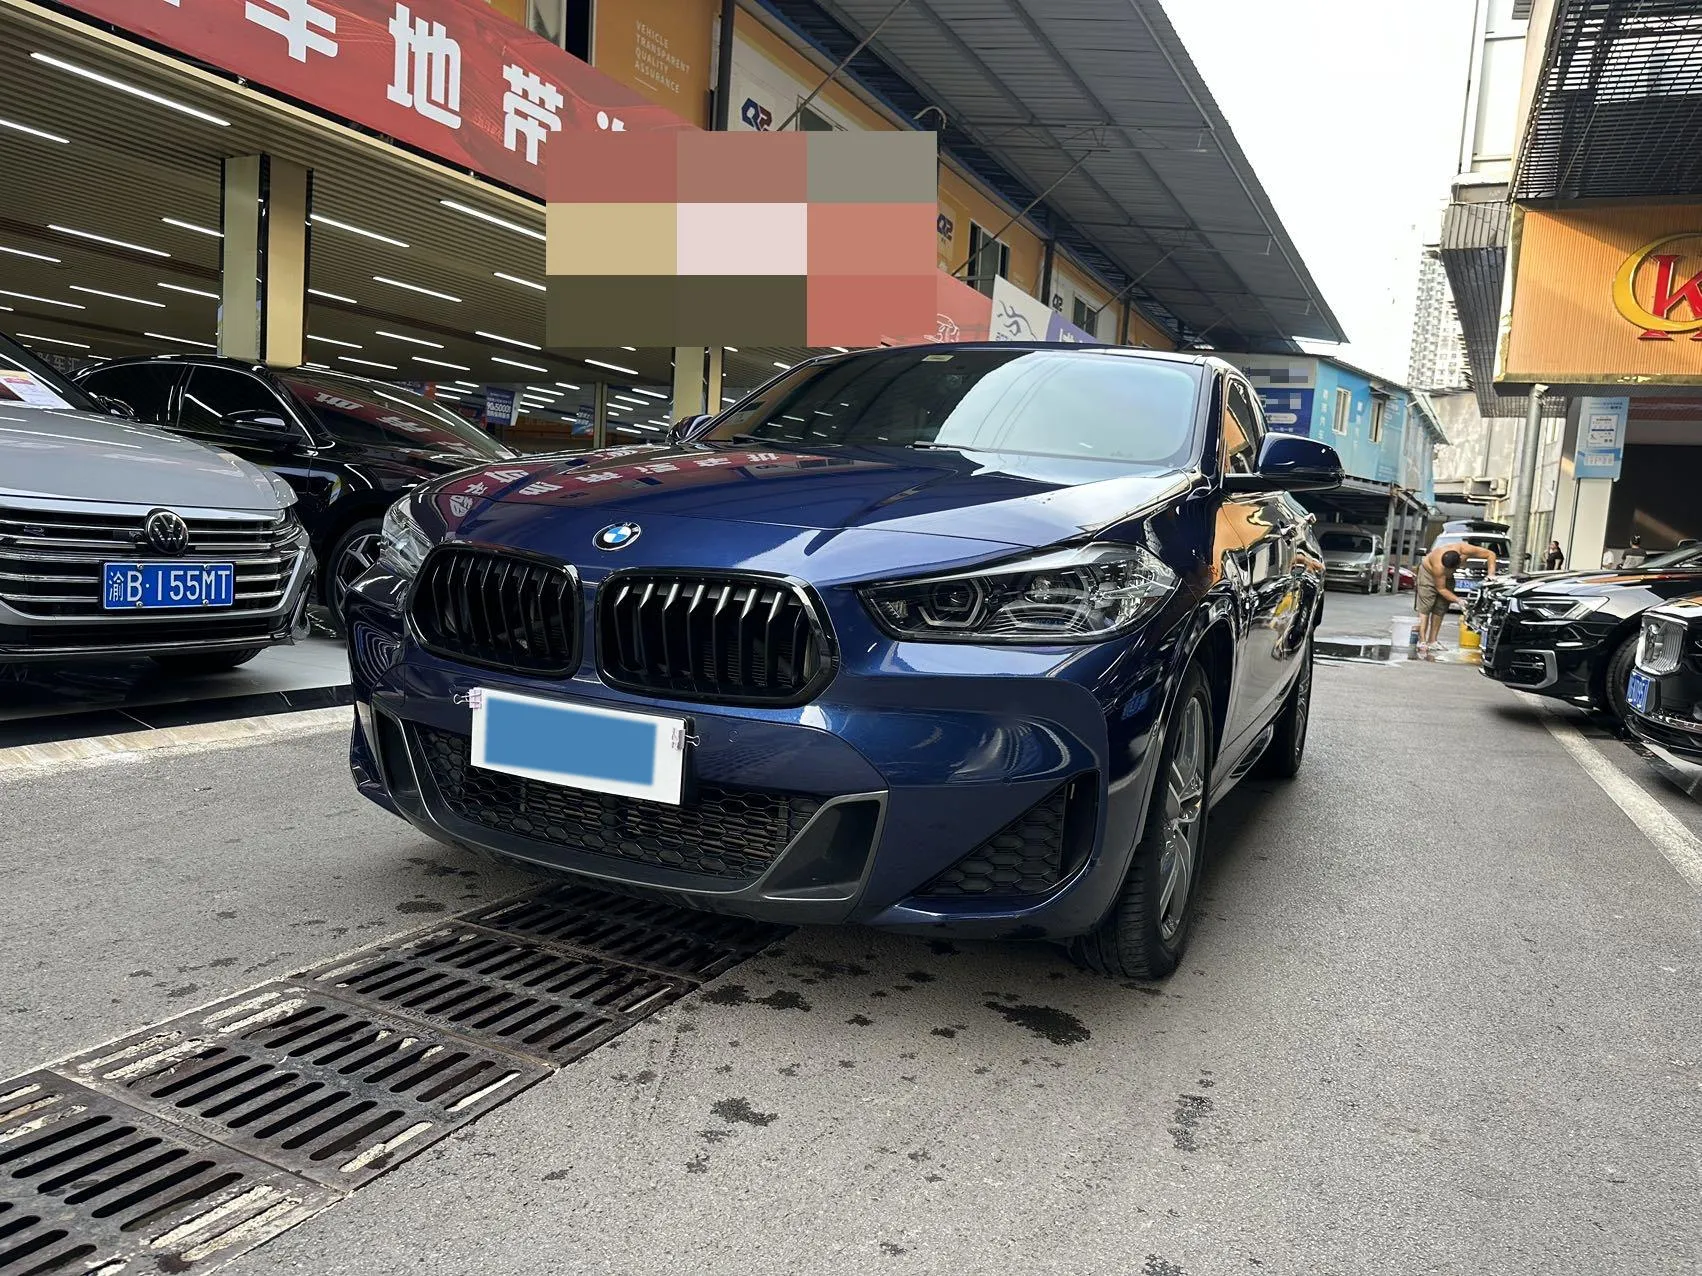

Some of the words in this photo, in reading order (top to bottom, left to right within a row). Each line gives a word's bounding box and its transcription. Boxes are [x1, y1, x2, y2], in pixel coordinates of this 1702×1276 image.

[636, 20, 669, 49] VEHICLE
[635, 47, 669, 75] QUALITY
[636, 33, 690, 75] TRANSPARENT
[634, 60, 680, 94] ASSURANCE
